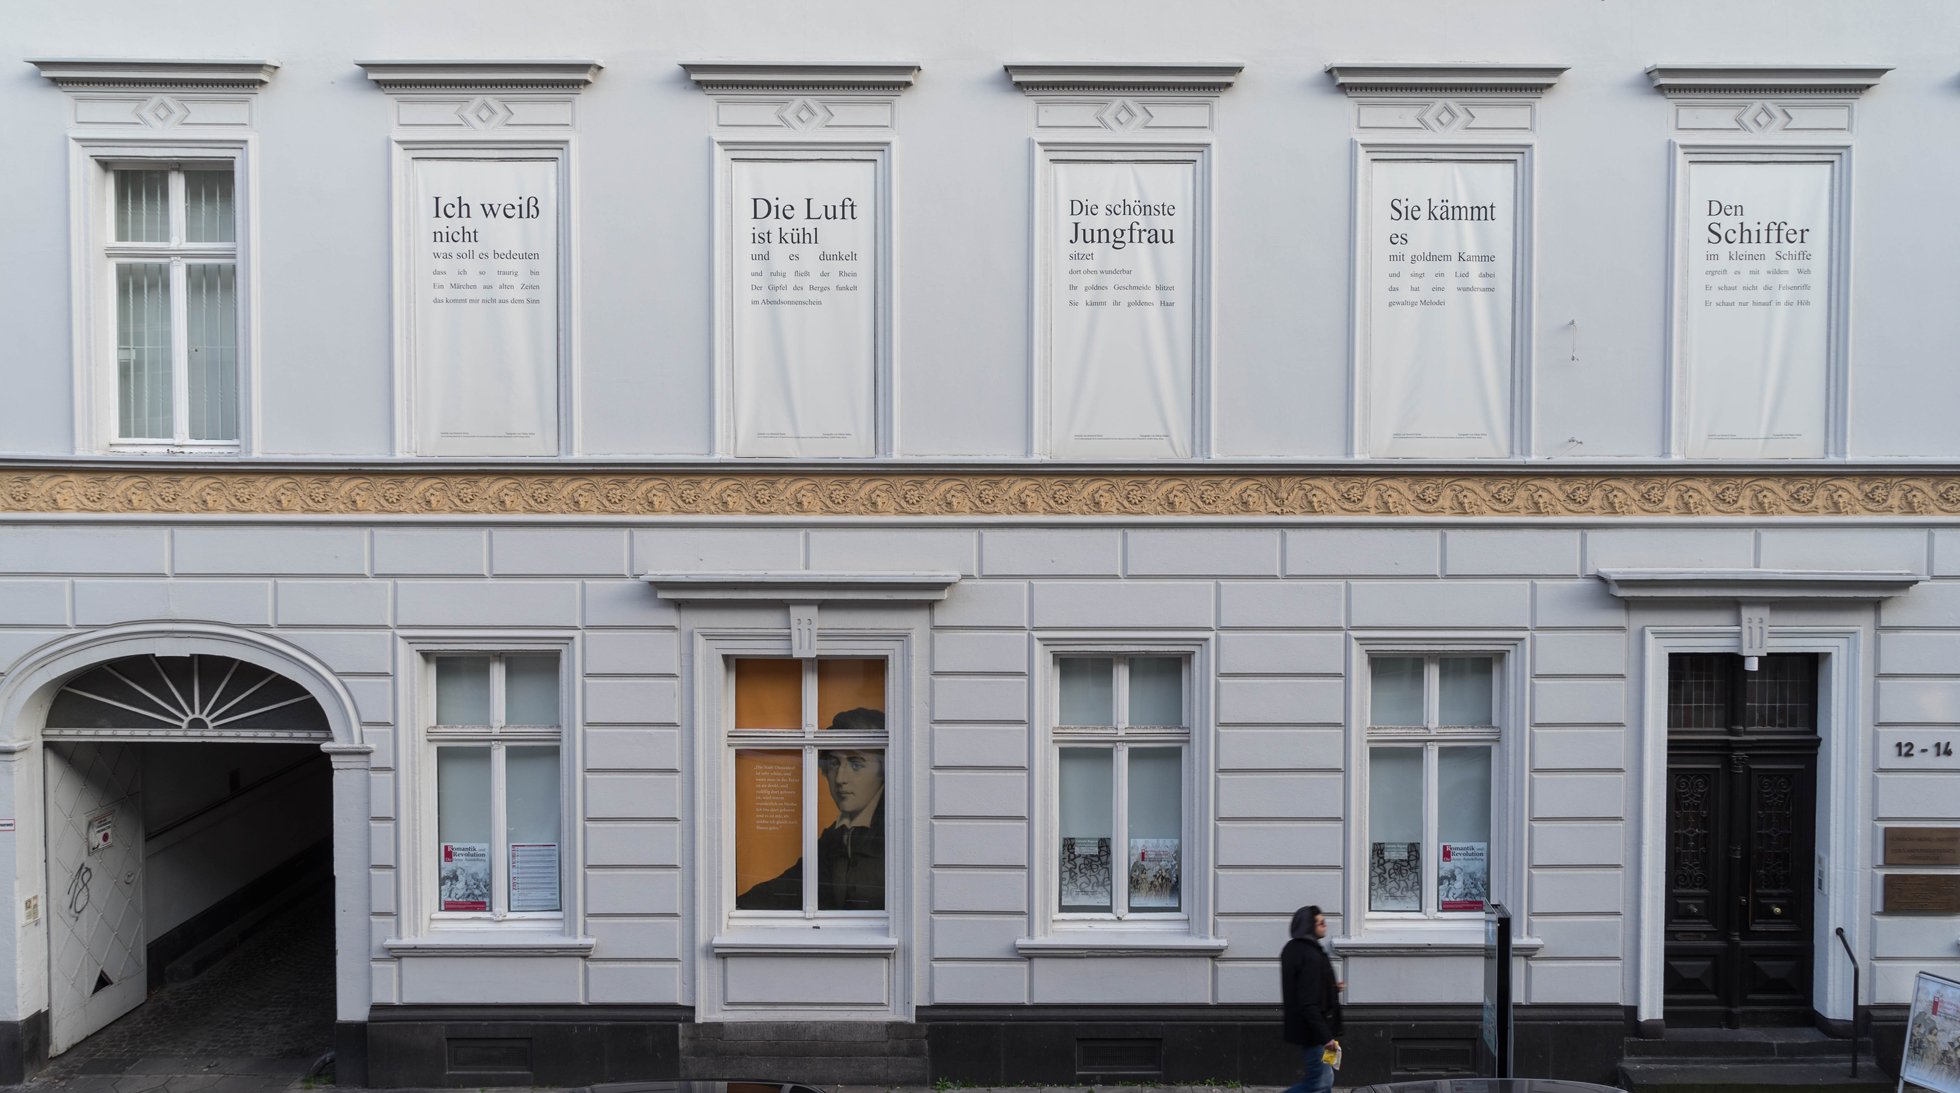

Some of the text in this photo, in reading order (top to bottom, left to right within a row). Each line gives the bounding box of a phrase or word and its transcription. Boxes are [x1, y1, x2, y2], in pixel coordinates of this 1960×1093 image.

[433, 196, 540, 219] Ich weiß
[751, 197, 857, 220] Die Luft
[1070, 199, 1175, 216] Die schönste
[1391, 198, 1496, 221] Sie kämmt
[1707, 200, 1744, 216] Den
[433, 226, 479, 242] nicht
[752, 227, 819, 244] ist kühl
[1070, 221, 1175, 249] Jungfrau
[1390, 233, 1408, 245] es
[1707, 221, 1810, 244] Schiffer
[433, 251, 453, 259] was
[457, 250, 474, 259] soll
[493, 250, 539, 259] bedeuten
[751, 251, 770, 261] und
[819, 251, 857, 261] dunkelt
[1069, 251, 1094, 260] sitzet
[1389, 252, 1495, 264] mit goldnem Kamme
[1706, 251, 1812, 261] im kleinen Schiffe
[1084, 284, 1108, 292] goldnes
[1895, 741, 1915, 757] 12
[1934, 741, 1953, 757] 14
